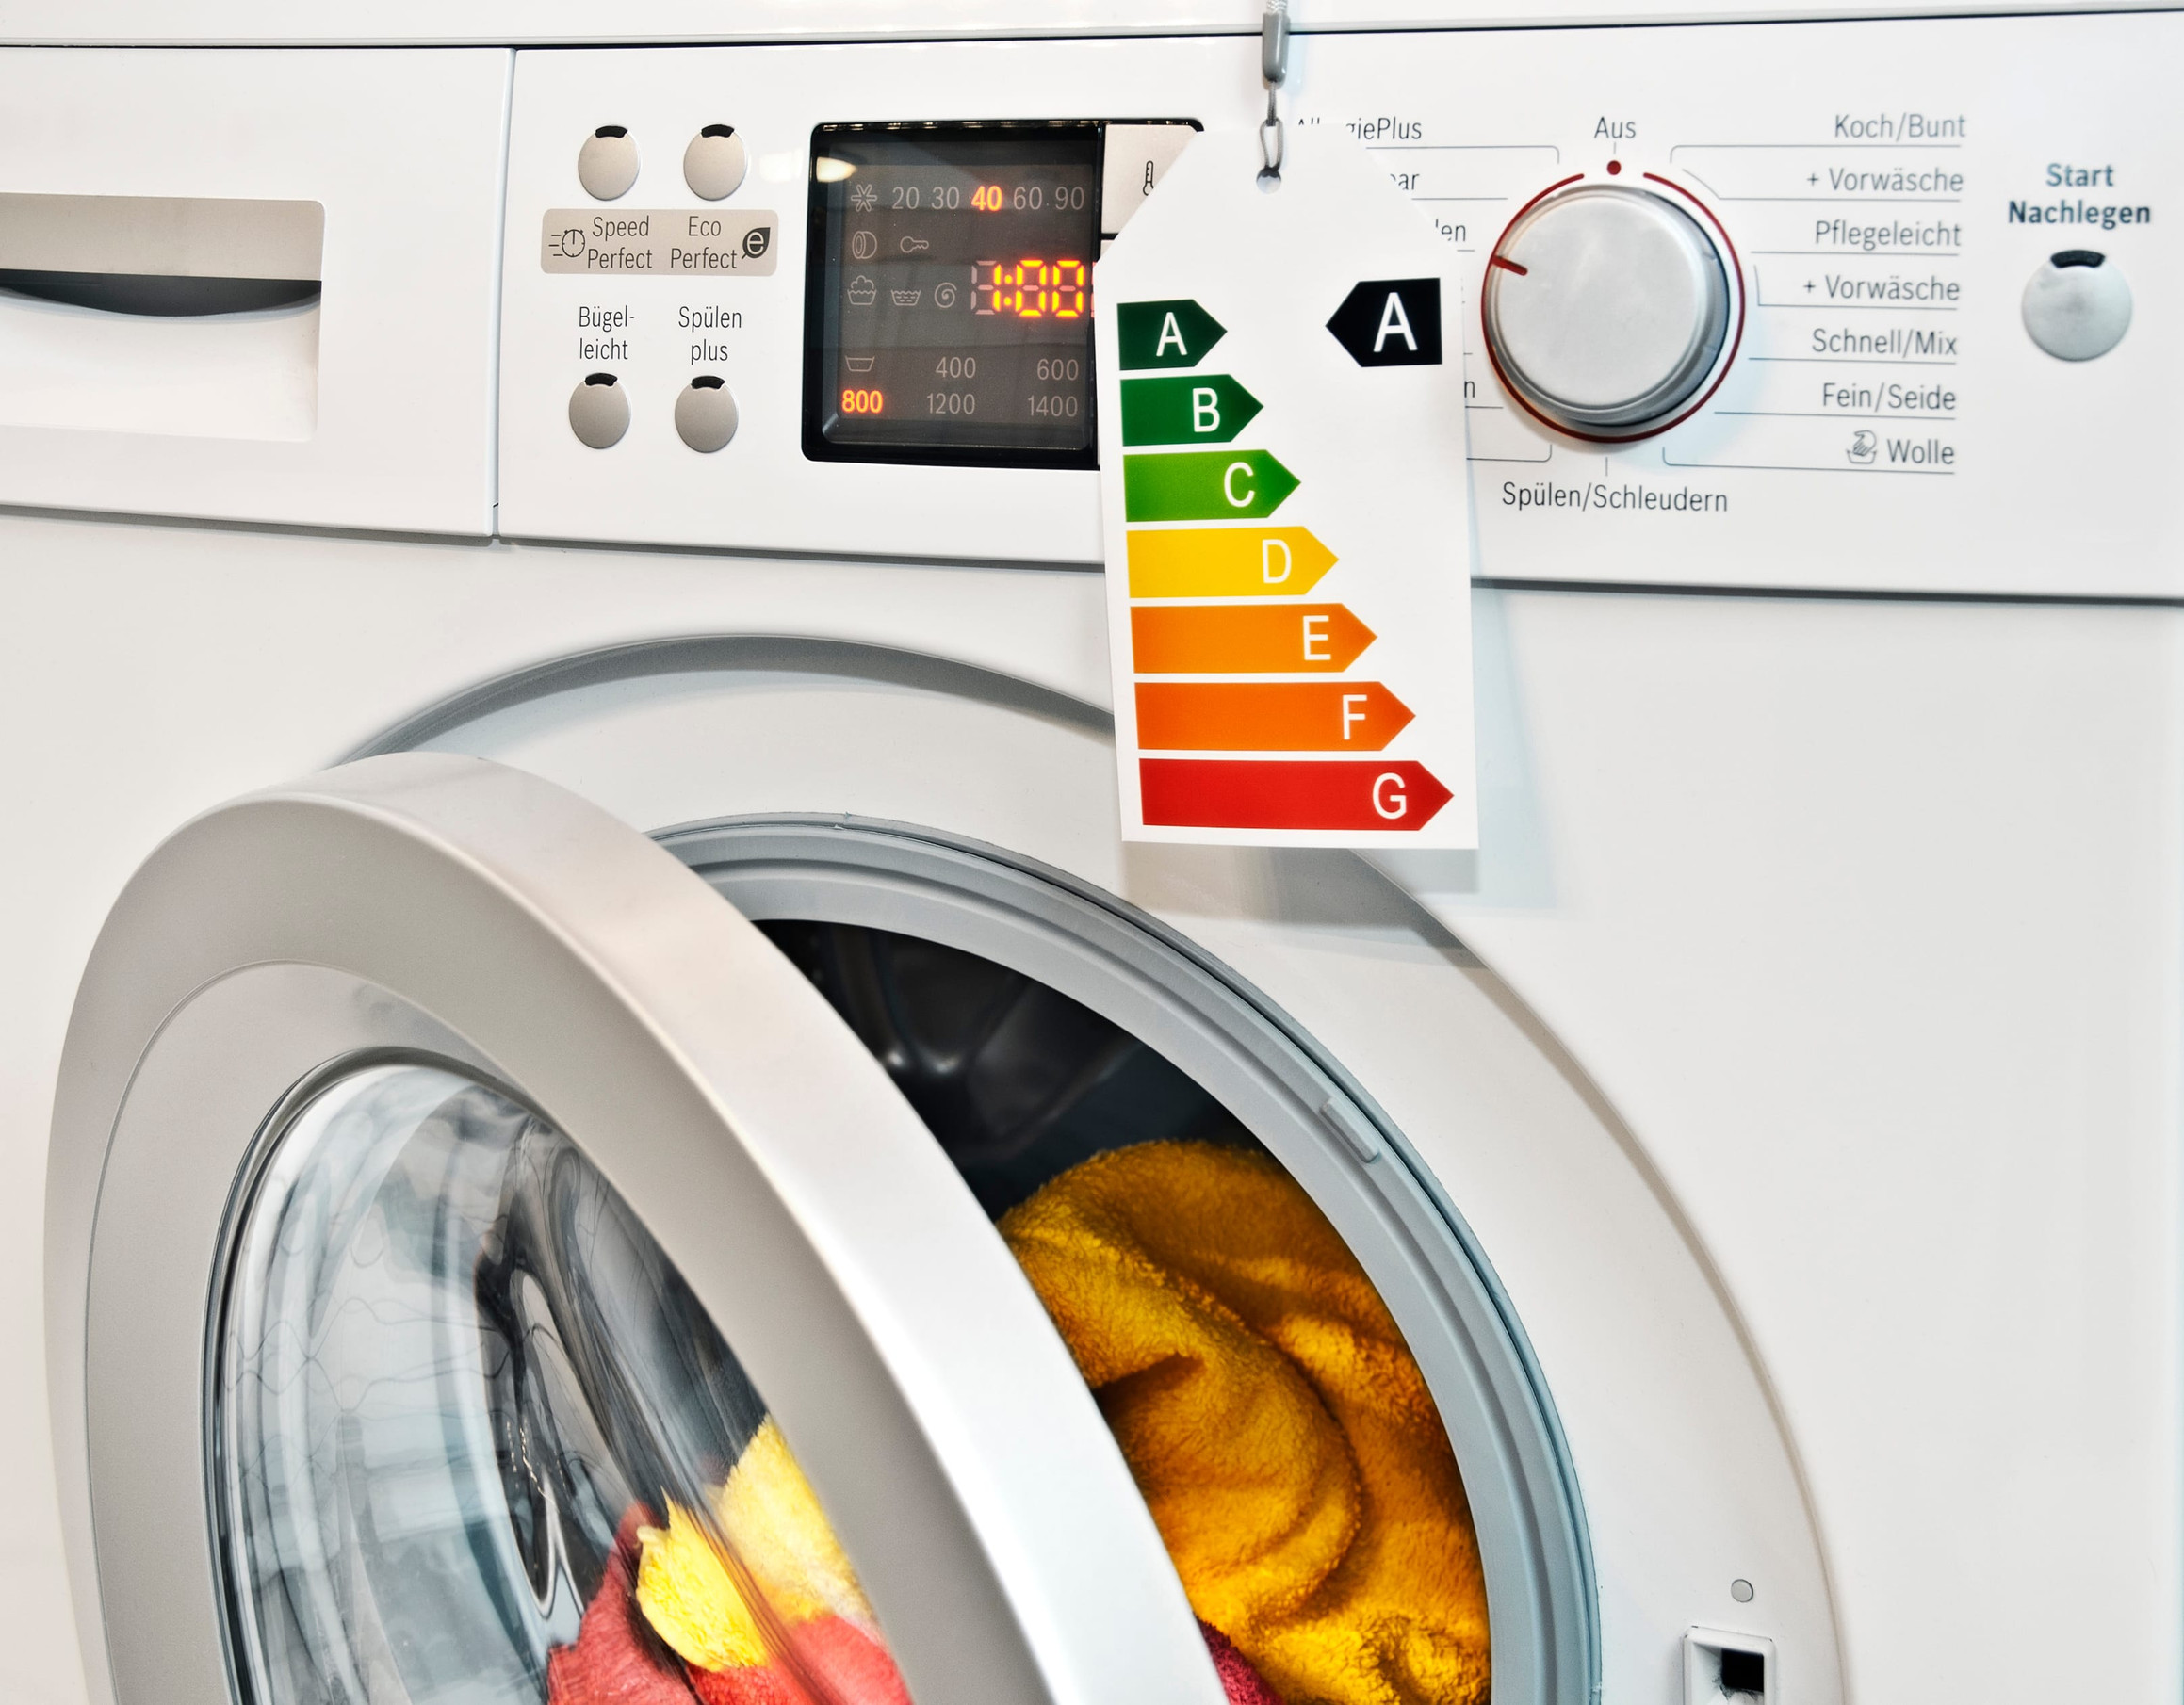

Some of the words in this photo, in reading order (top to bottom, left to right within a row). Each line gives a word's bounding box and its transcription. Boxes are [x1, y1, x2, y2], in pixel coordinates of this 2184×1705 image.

[1594, 116, 1637, 139] Aus
[1834, 113, 1966, 141] Koch/Bunt
[1829, 167, 1964, 193] Vorwäsche
[2045, 163, 2114, 187] Start
[892, 187, 920, 210] 20
[931, 187, 960, 210] 30
[971, 185, 1003, 212] 40
[1013, 187, 1043, 210] 60
[1054, 187, 1084, 210] 90
[593, 216, 650, 240] Speed
[688, 216, 722, 237] Eco
[2008, 200, 2152, 229] Nachlegen
[1815, 220, 1962, 251] Pflegeleicht
[587, 248, 653, 269] Perfect
[671, 248, 737, 269] Perfect
[992, 260, 1084, 317] 1:00
[1825, 274, 1960, 301] Vorwäsche
[579, 305, 635, 332] Bügel-
[678, 306, 742, 332] Spülen
[1373, 291, 1418, 353] A
[1156, 311, 1188, 358] A
[1811, 328, 1958, 357] Schnell/Mix
[579, 338, 628, 360] leicht
[691, 339, 729, 365] plus
[936, 357, 977, 379] 400
[1037, 359, 1079, 381] 600
[841, 389, 884, 414] 800
[928, 394, 976, 414] 1200
[1028, 396, 1078, 417] 1400
[1193, 387, 1221, 433] B
[1822, 382, 1957, 412] Fein/Seide
[1886, 438, 1956, 465] Wolle
[1223, 462, 1256, 508] C
[1502, 481, 1728, 512] Spülen/Schleudern
[1262, 539, 1292, 584] D
[1303, 615, 1332, 662] E
[1343, 694, 1368, 741] F
[1372, 772, 1408, 820] G
